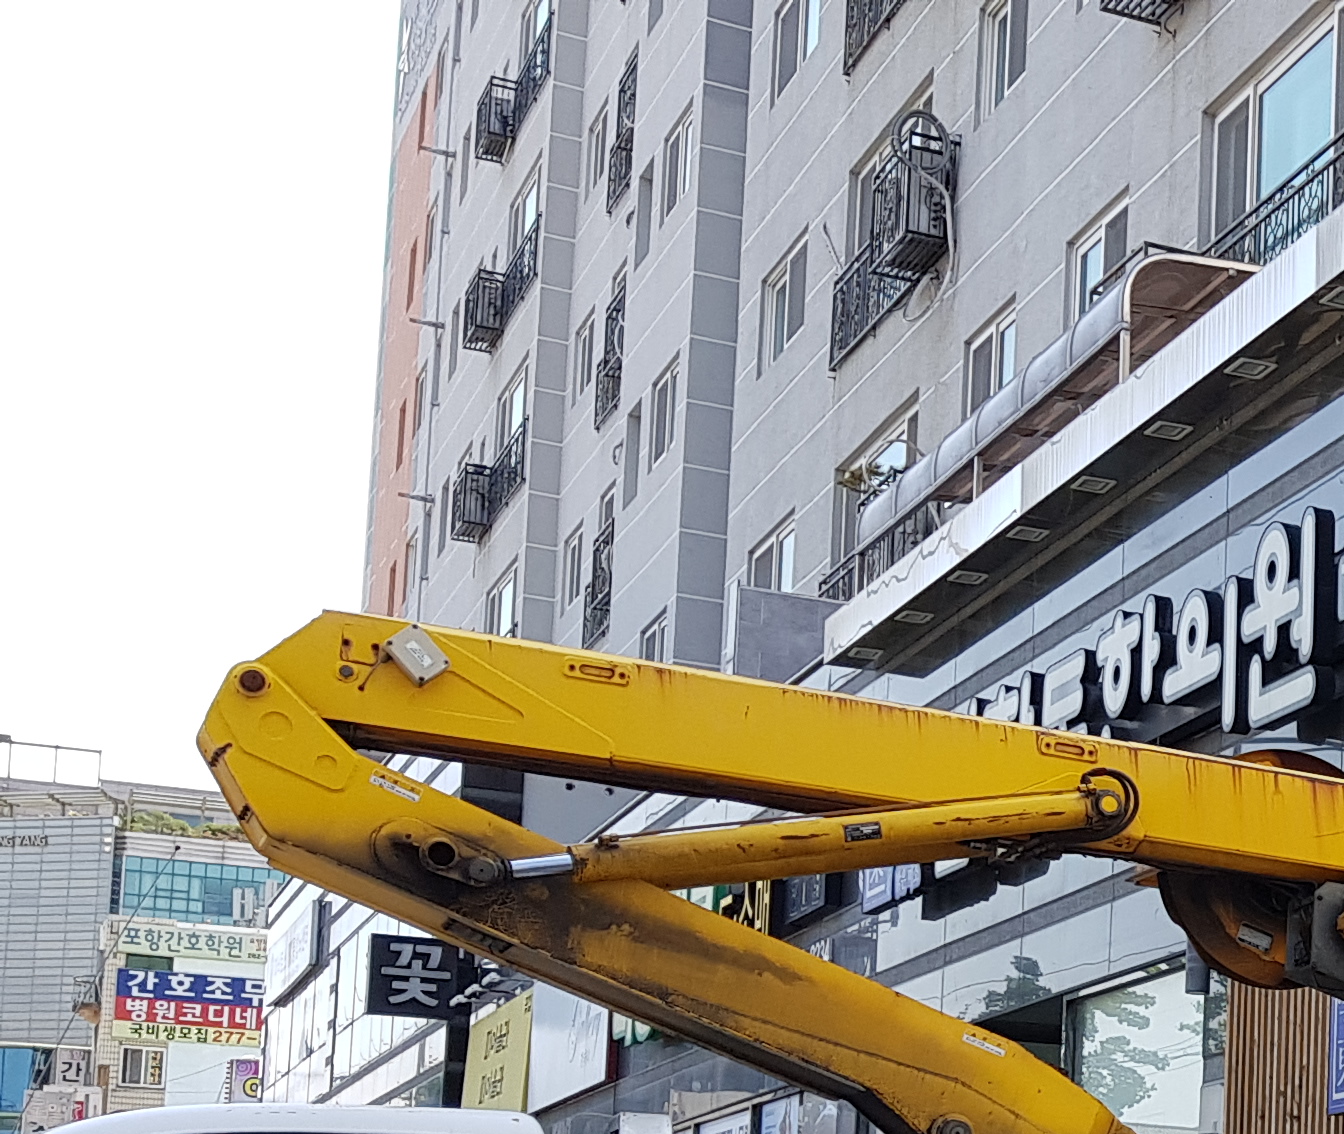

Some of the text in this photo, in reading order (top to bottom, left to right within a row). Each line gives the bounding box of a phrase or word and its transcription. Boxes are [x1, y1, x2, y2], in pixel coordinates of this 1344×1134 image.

[122, 927, 243, 958] 포항간호학원
[381, 942, 451, 1007] 꽃
[125, 998, 256, 1030] 병원코디네
